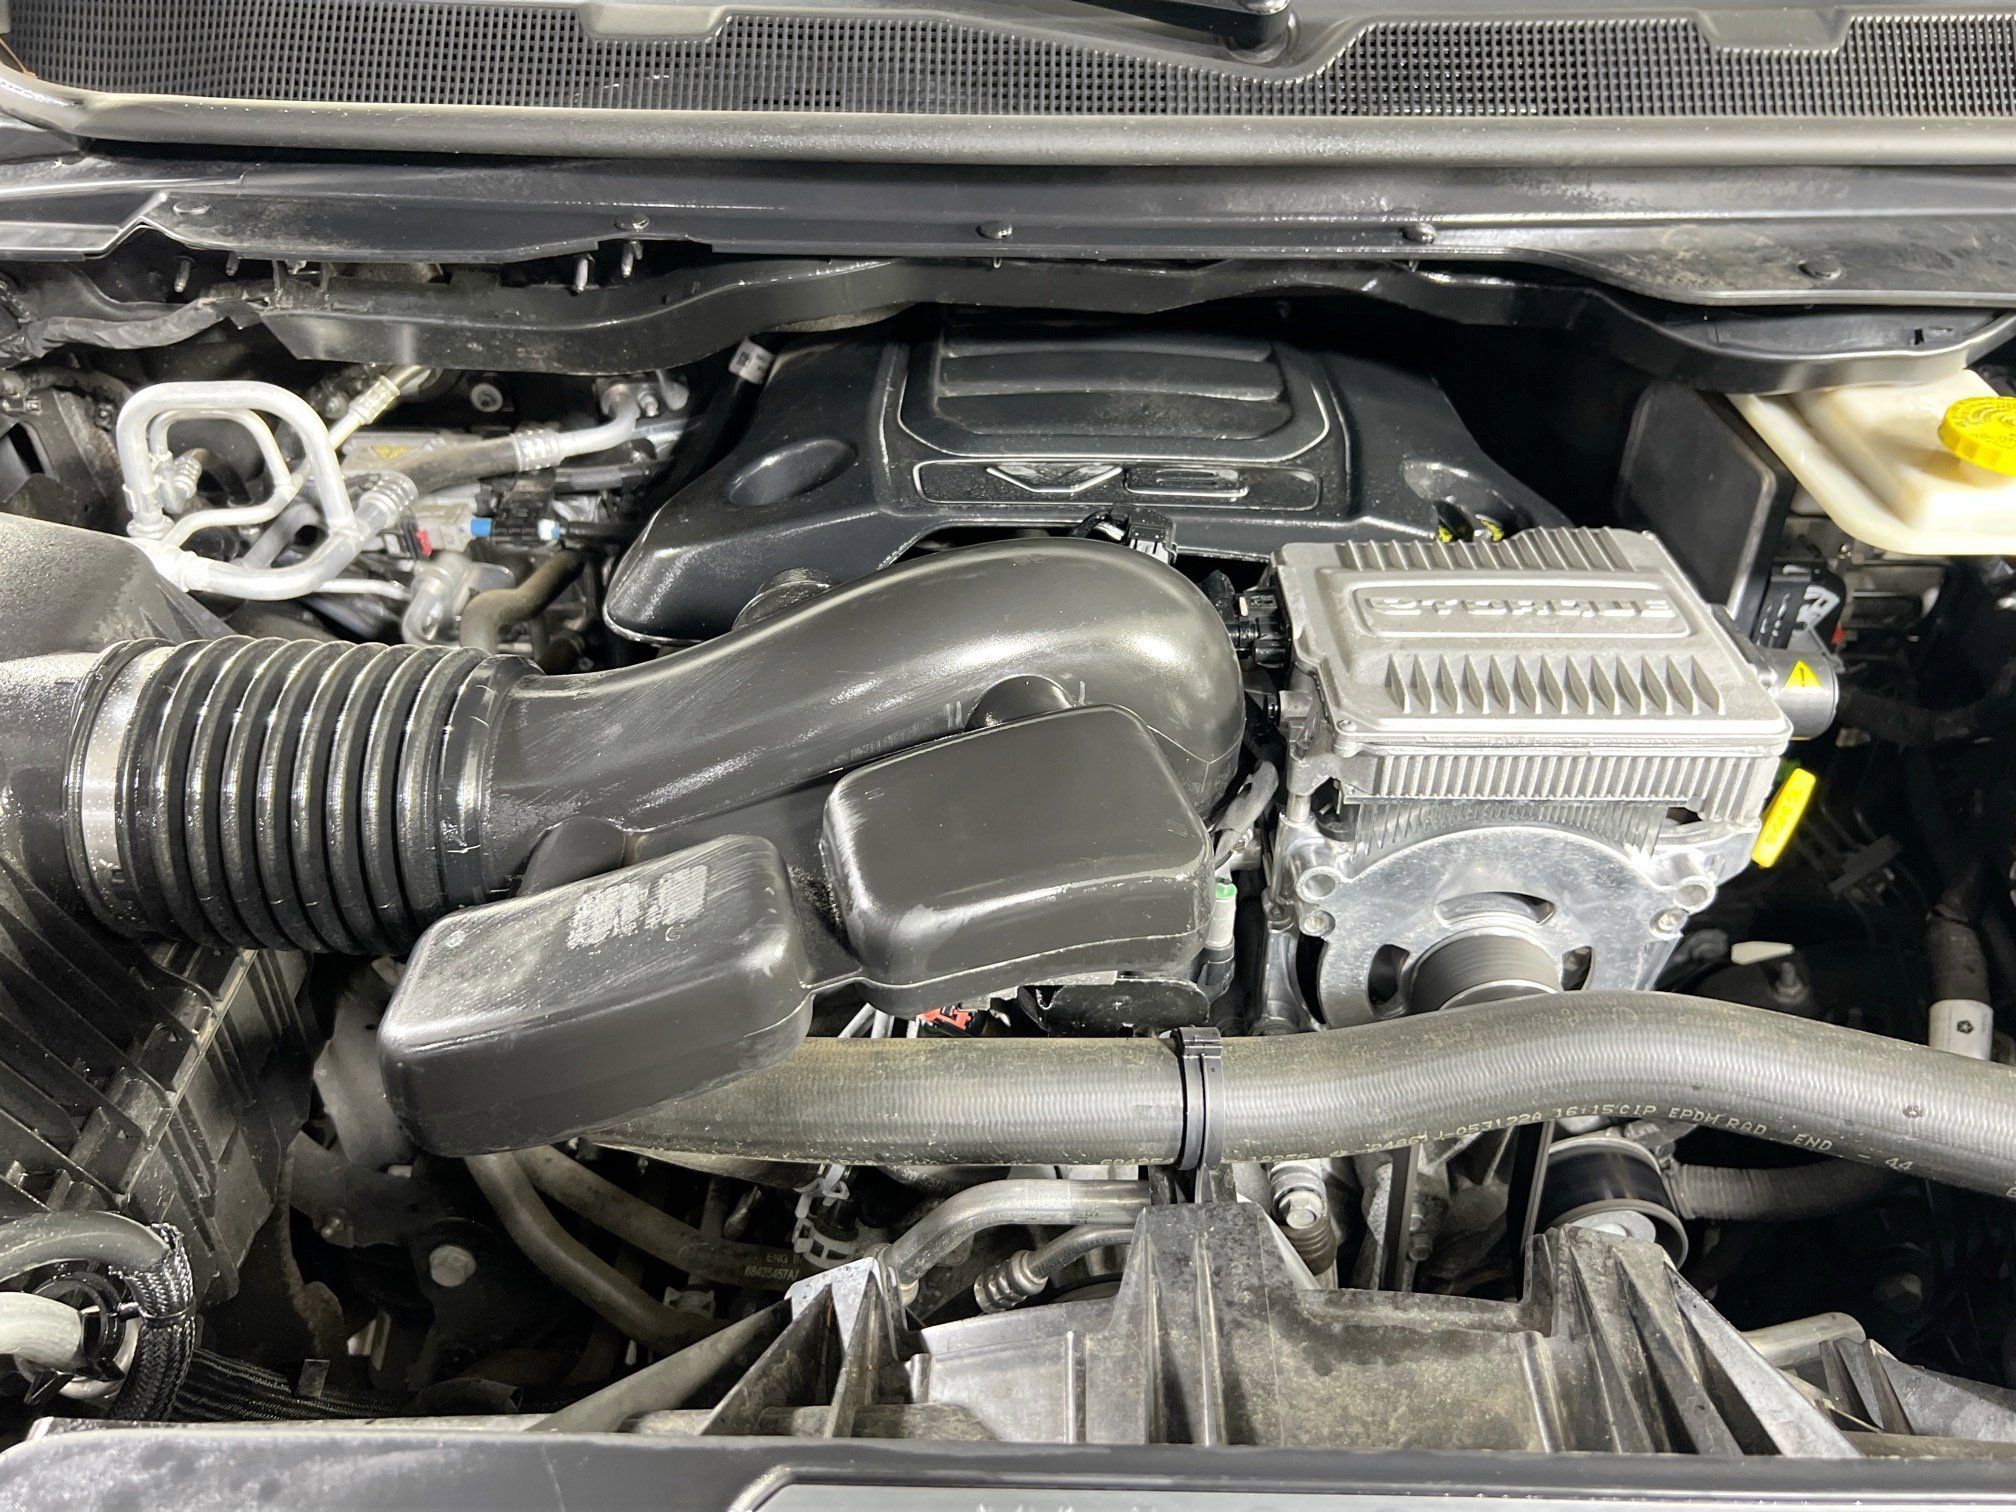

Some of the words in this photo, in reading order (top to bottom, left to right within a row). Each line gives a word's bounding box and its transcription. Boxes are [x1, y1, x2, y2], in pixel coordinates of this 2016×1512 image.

[1667, 1106, 1721, 1126] EPDM
[1725, 1117, 1767, 1135] RAD
[1792, 1133, 1833, 1151] END
[1884, 1157, 1914, 1171] 44
